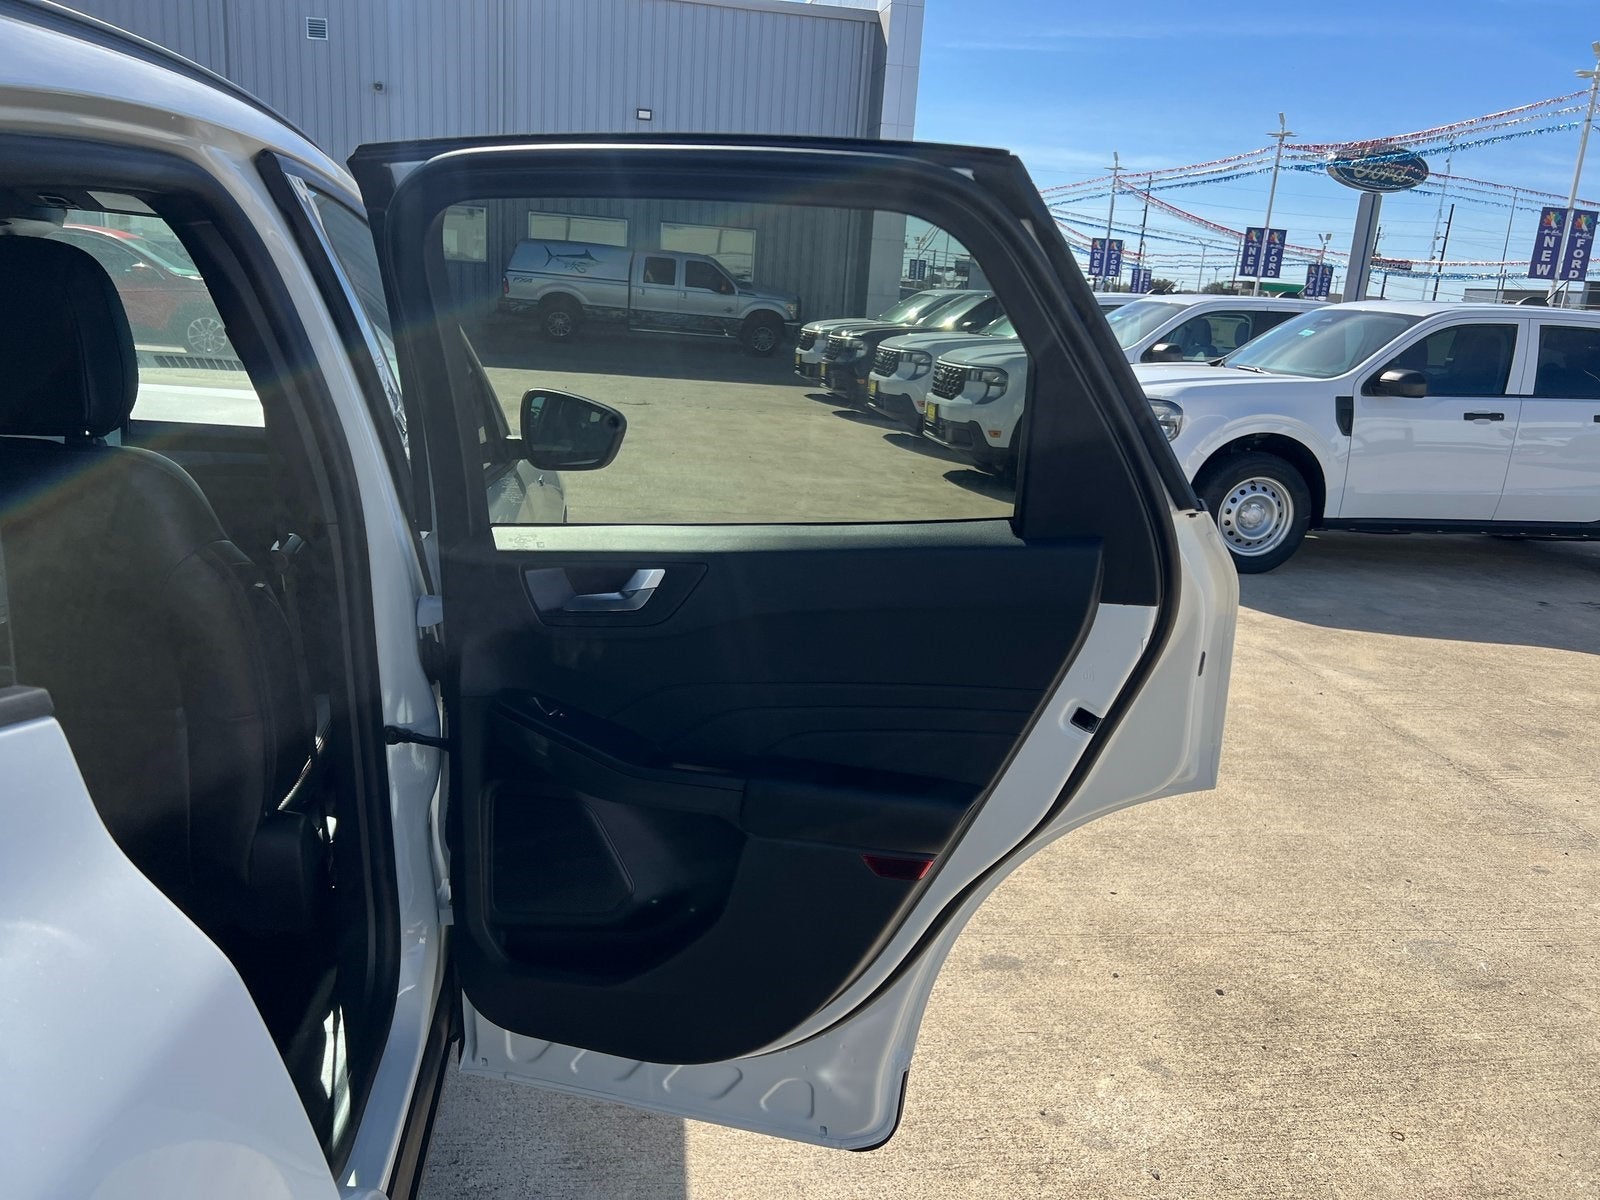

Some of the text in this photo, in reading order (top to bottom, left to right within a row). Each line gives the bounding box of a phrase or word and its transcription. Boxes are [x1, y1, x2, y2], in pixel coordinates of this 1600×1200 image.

[1350, 153, 1415, 182] Ford
[1092, 253, 1101, 274] NEW
[1109, 254, 1118, 275] FORD
[1244, 246, 1257, 275] NEW
[1267, 248, 1279, 277] FORD
[1536, 236, 1555, 276] NEW
[1568, 239, 1586, 279] FORD
